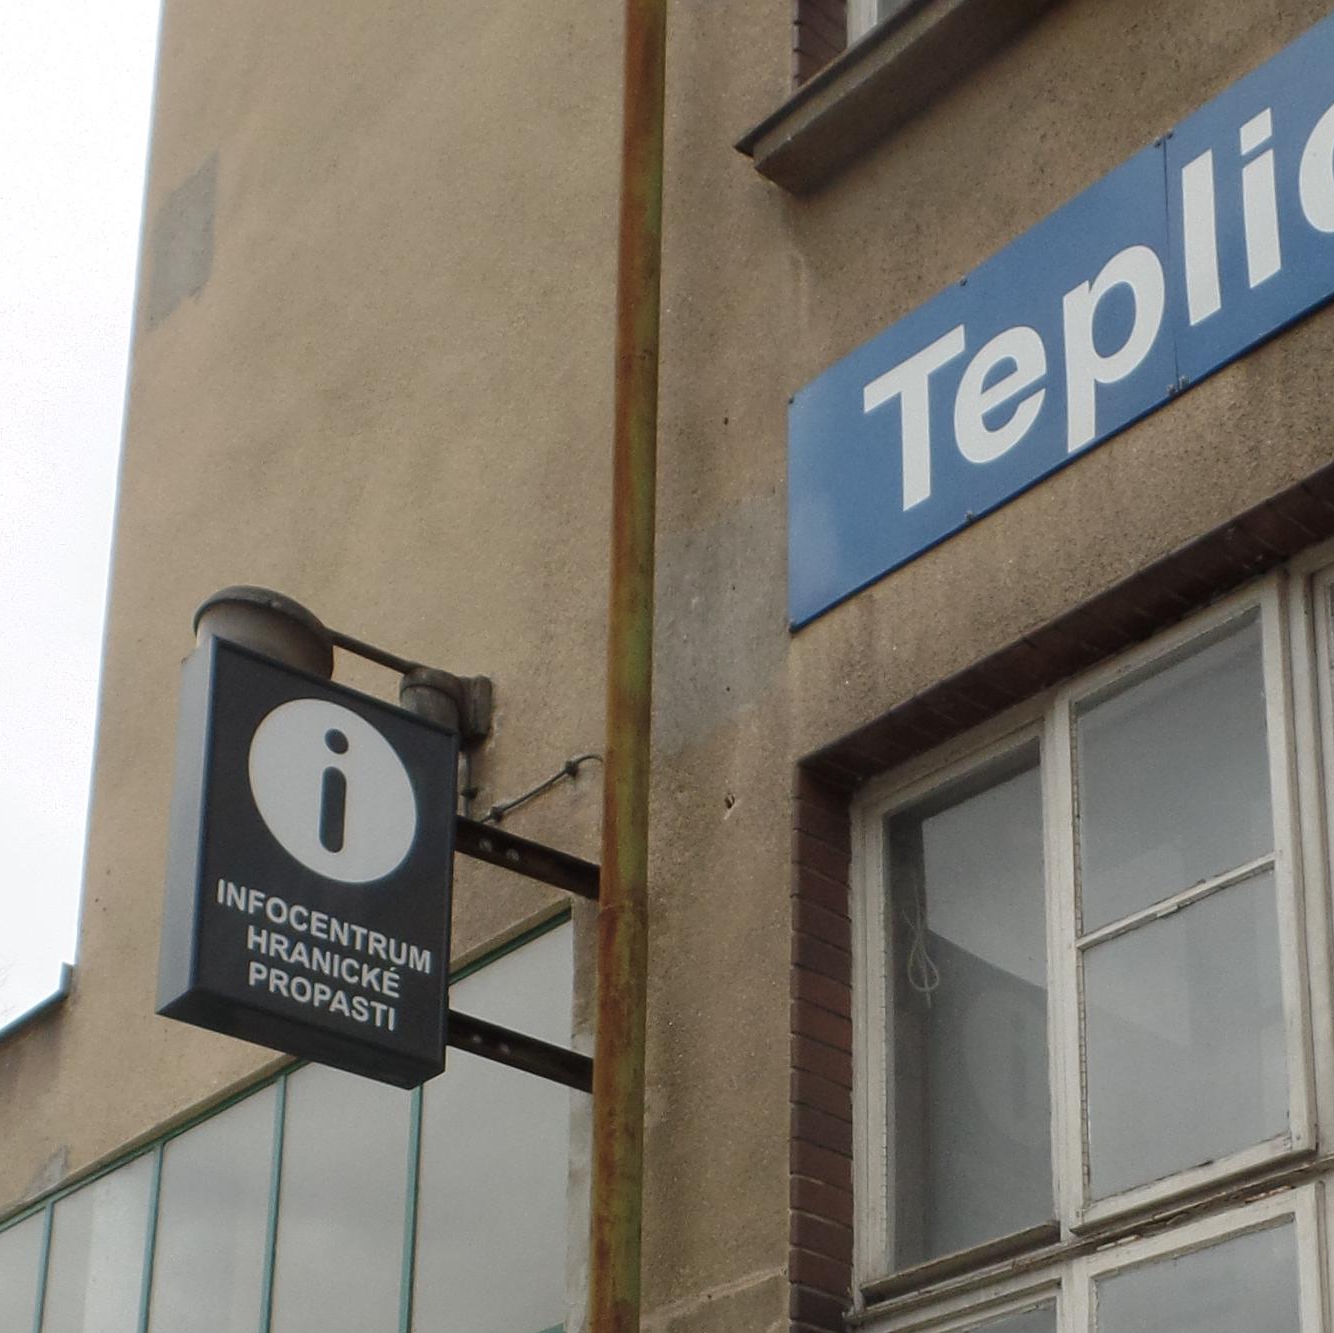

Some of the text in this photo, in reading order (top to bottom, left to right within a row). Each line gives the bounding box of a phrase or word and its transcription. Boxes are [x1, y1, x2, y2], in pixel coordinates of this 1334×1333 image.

[217, 879, 432, 974] INFOCENTRUM
[247, 926, 400, 998] HRANICKÉ
[248, 962, 397, 1031] PROPASTI
